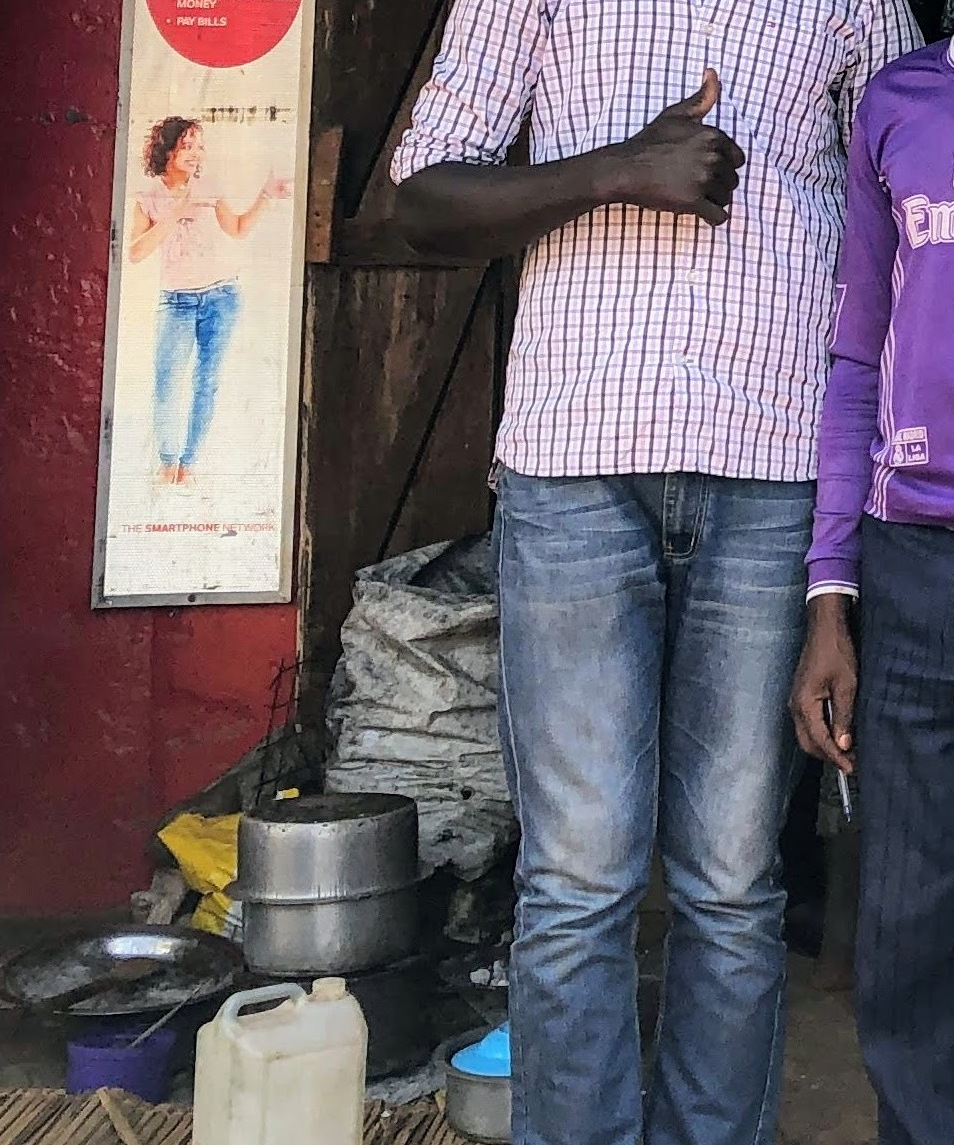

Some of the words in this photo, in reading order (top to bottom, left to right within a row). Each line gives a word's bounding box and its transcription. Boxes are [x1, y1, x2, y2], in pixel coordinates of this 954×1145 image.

[176, 0, 217, 9] MONEY
[176, 17, 196, 26] PAY
[197, 17, 228, 27] BILLS
[121, 523, 143, 534] THE
[144, 523, 220, 534] SMARTPHONE
